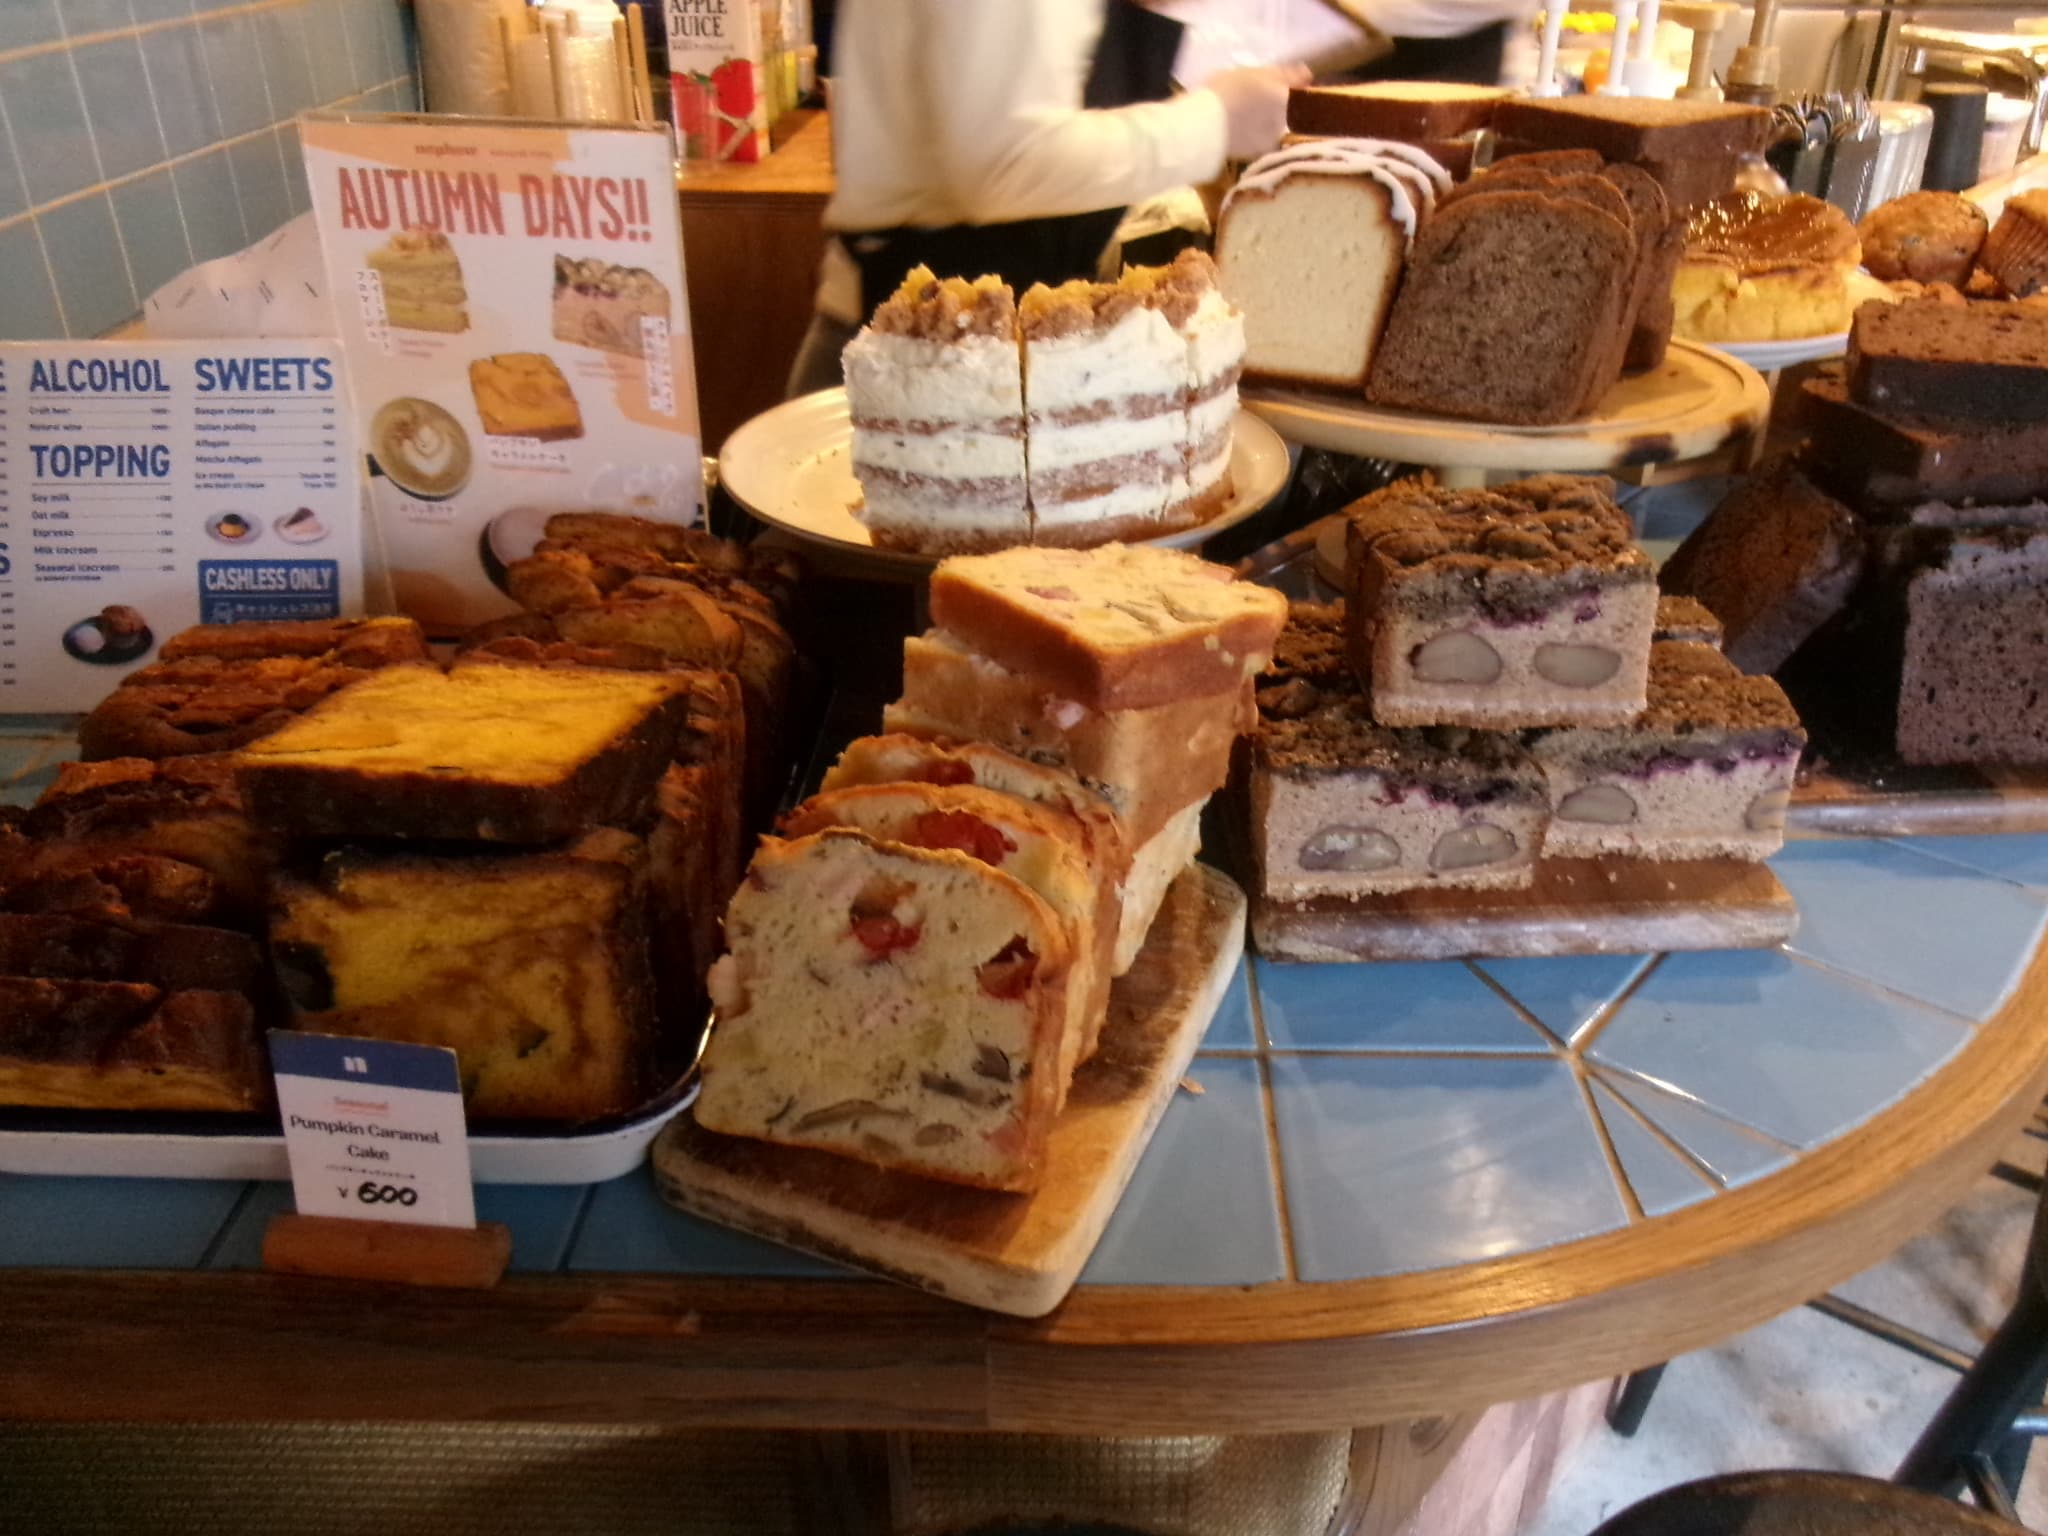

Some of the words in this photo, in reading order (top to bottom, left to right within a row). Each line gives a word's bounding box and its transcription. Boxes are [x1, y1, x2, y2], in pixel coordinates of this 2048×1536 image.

[671, 16, 724, 37] JUICE
[338, 167, 505, 235] AUTUMN
[519, 174, 652, 243] DAYS!!
[30, 359, 170, 393] ALCOHOL
[194, 357, 333, 392] SWEETS
[30, 445, 170, 478] TOPPING
[205, 567, 287, 591] CASHLESS
[289, 567, 333, 590] ONLY
[290, 1114, 364, 1136] Pumpkin
[368, 1123, 440, 1144] Caramel
[347, 1145, 390, 1161] Cake
[357, 1181, 418, 1206] 600
